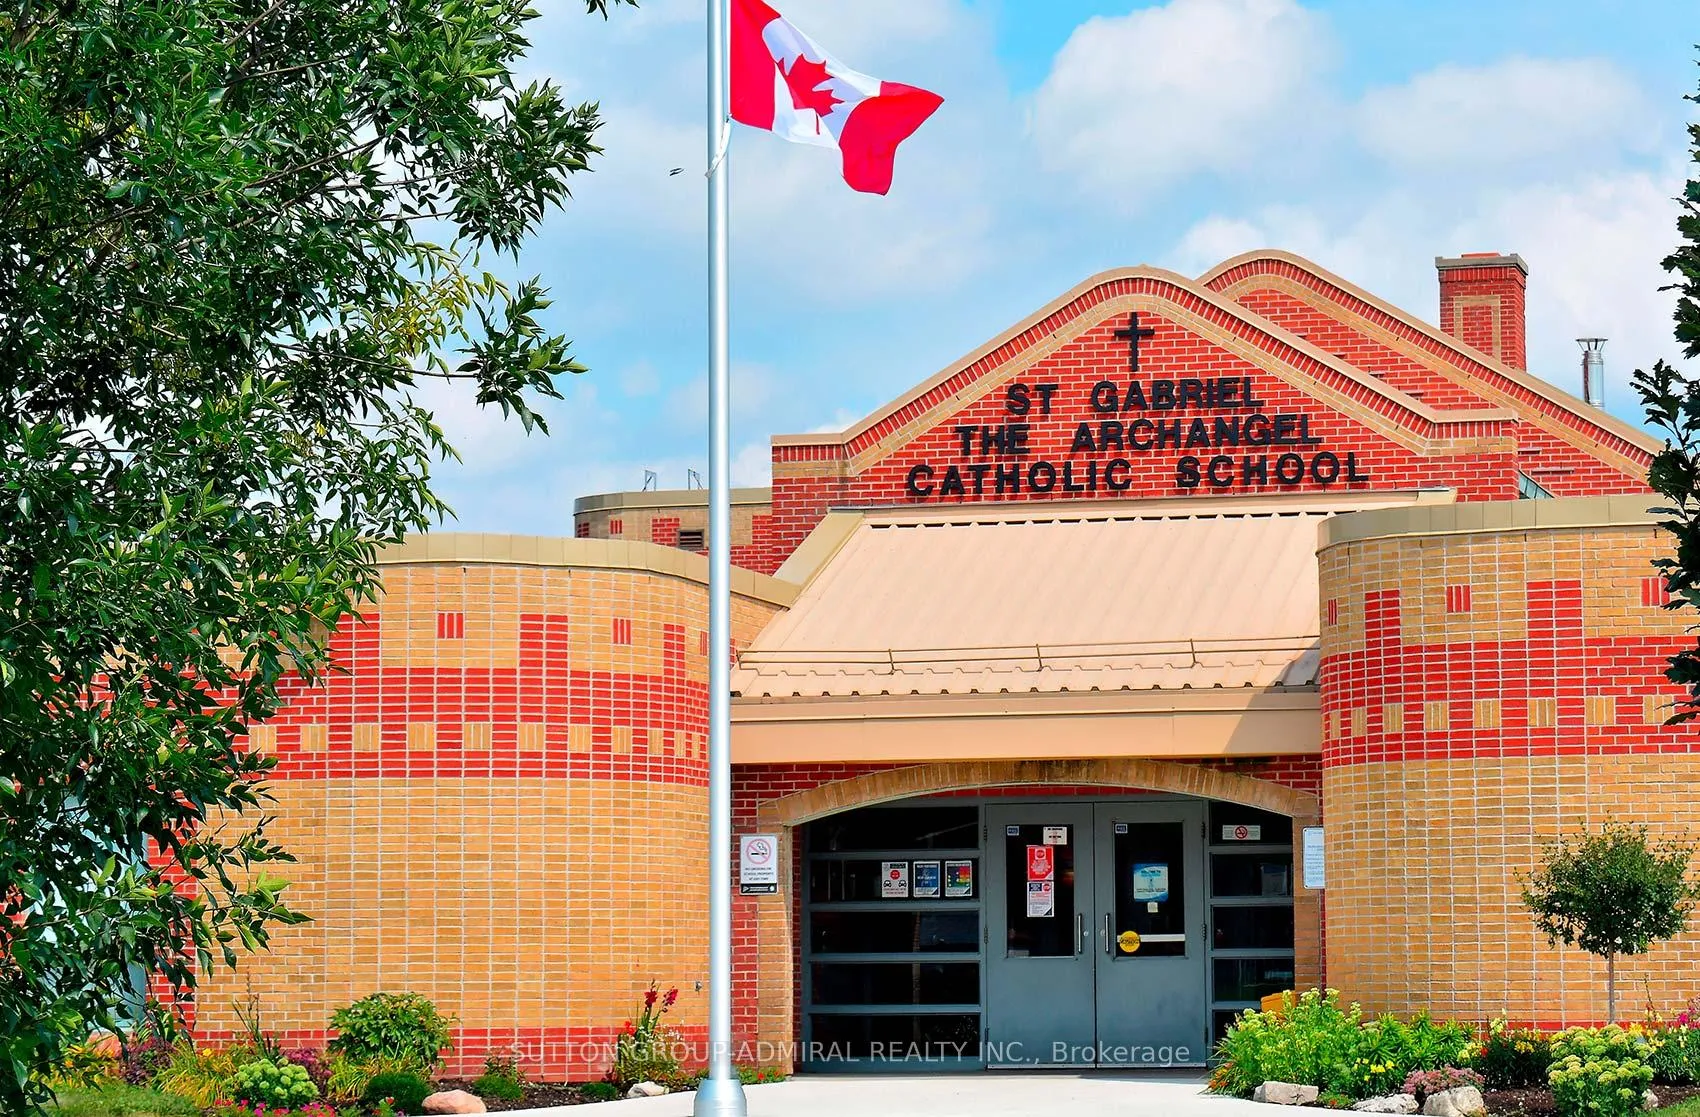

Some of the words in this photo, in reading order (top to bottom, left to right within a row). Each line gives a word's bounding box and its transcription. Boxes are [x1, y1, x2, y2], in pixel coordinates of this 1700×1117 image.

[1007, 382, 1058, 415] ST
[1091, 376, 1264, 413] GABRIEL
[955, 424, 1031, 456] THE
[1072, 414, 1321, 452] ARCHANGEL
[908, 459, 1132, 497] CATHOLIC
[1176, 452, 1368, 488] SCHOOL
